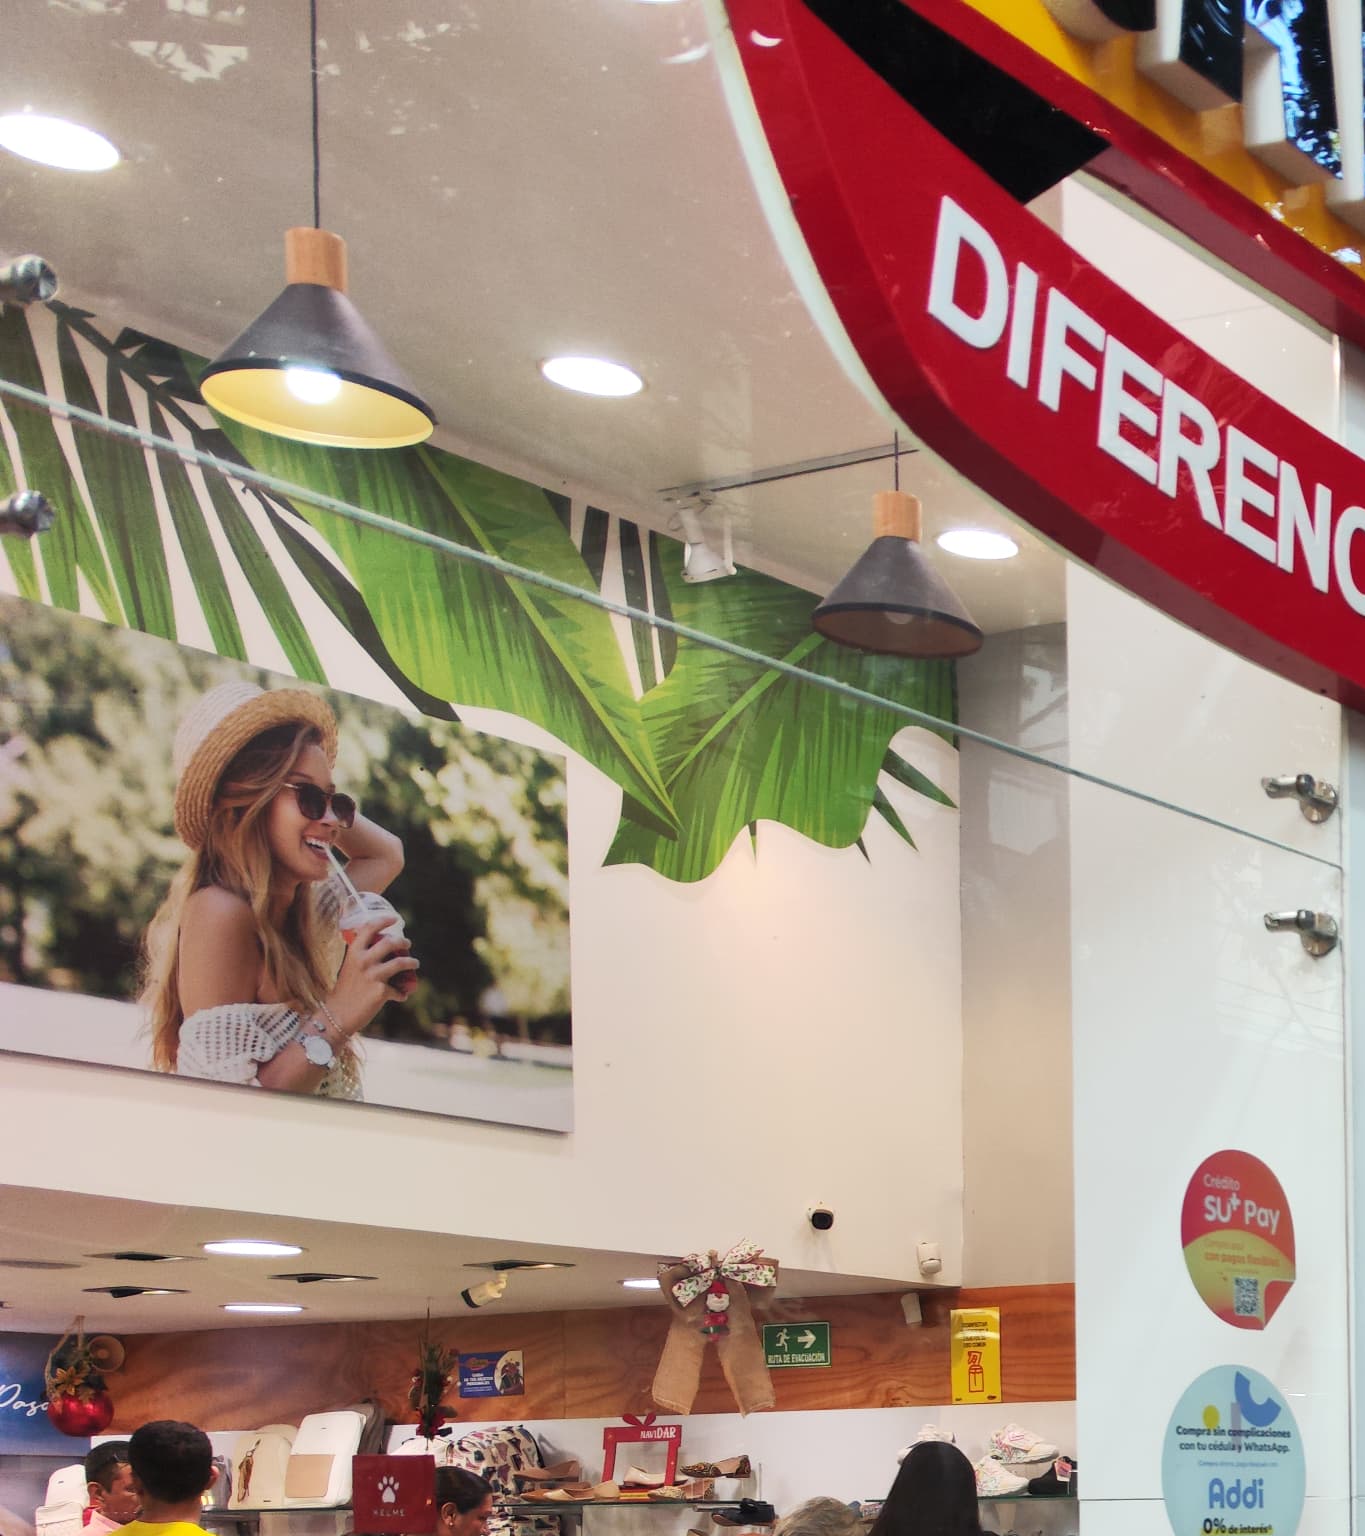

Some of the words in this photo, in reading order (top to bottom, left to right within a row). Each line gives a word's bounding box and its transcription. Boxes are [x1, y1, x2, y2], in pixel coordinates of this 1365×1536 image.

[1203, 1174, 1240, 1191] Crédito
[1244, 1200, 1280, 1235] Pay
[1176, 1425, 1212, 1437] Compra
[1213, 1426, 1226, 1437] sin
[1227, 1427, 1291, 1439] complicaciones
[1179, 1442, 1195, 1450] con
[1208, 1441, 1236, 1451] cédula
[1208, 1477, 1264, 1509] Addi
[1203, 1517, 1227, 1534] 0%
[1229, 1524, 1239, 1534] de
